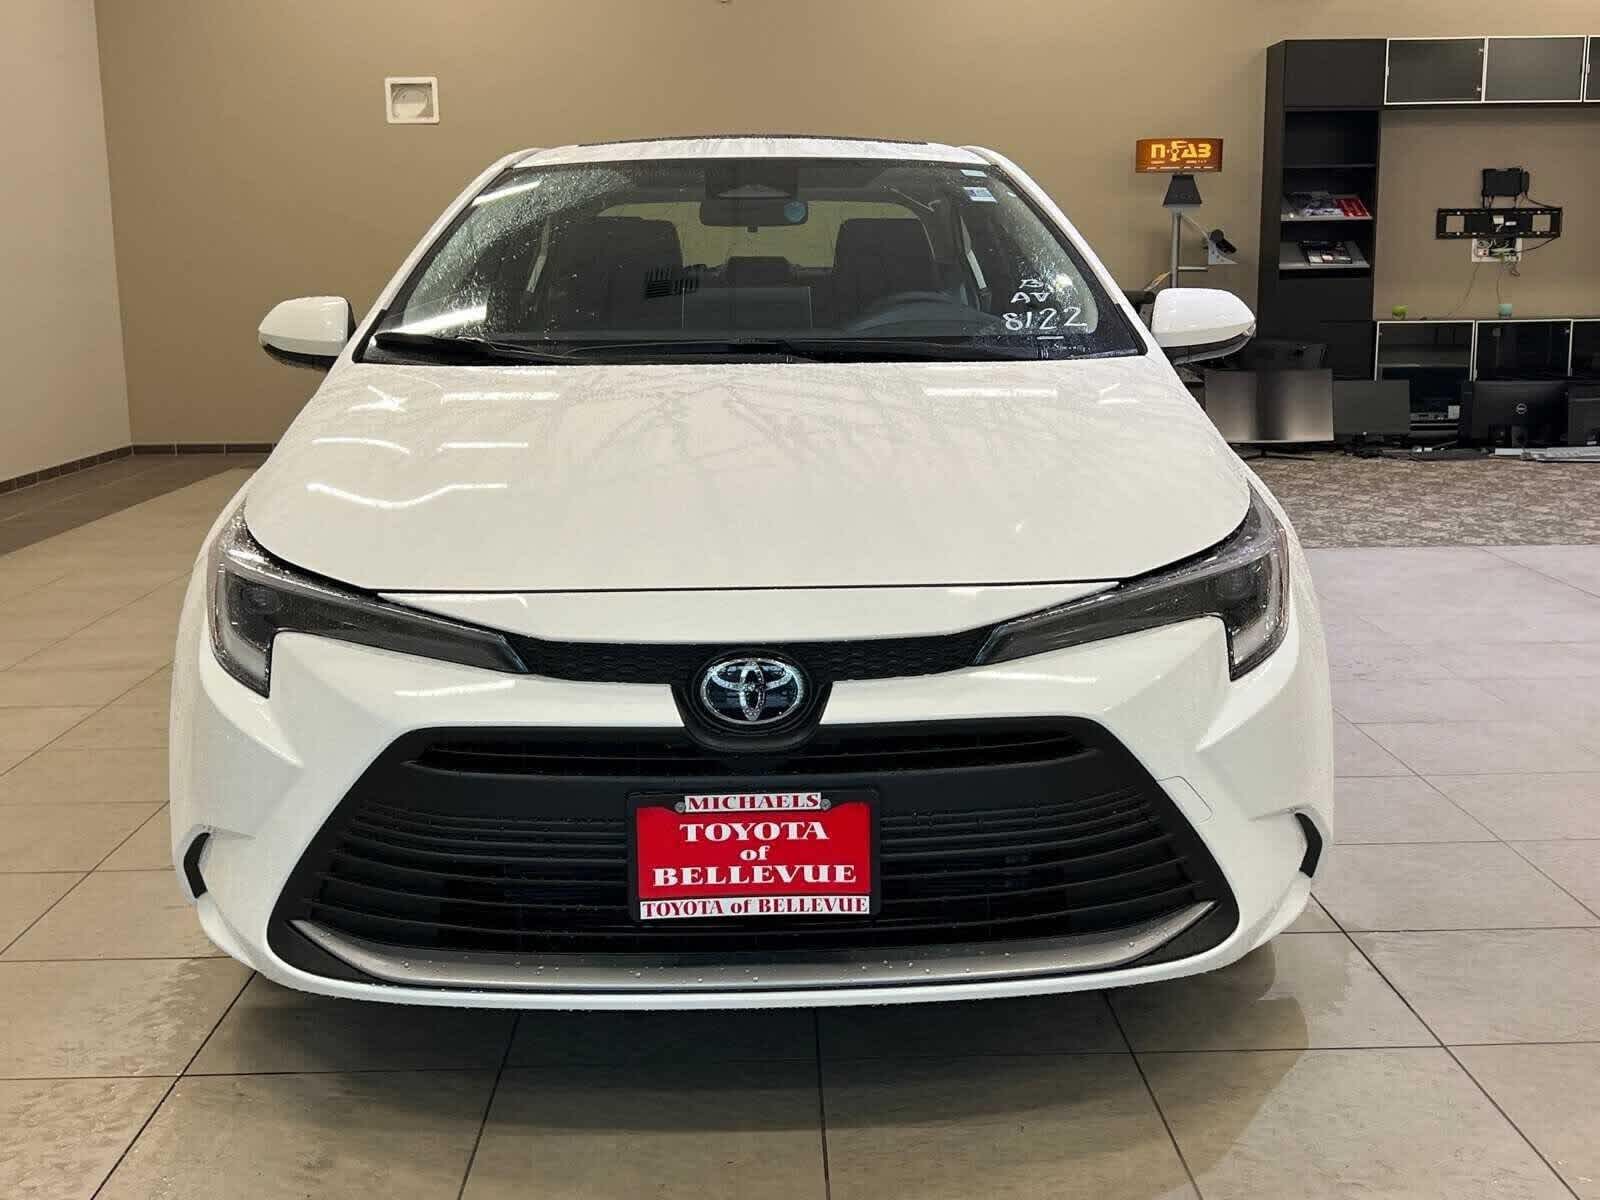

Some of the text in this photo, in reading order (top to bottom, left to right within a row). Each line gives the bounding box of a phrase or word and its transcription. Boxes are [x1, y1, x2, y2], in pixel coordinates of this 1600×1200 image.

[688, 794, 819, 810] MICHAELS
[680, 821, 830, 842] TOYOTA
[740, 845, 771, 861] of
[653, 864, 857, 887] BELLEVUE
[642, 898, 868, 917] TOYOTA of BELLEVUE
